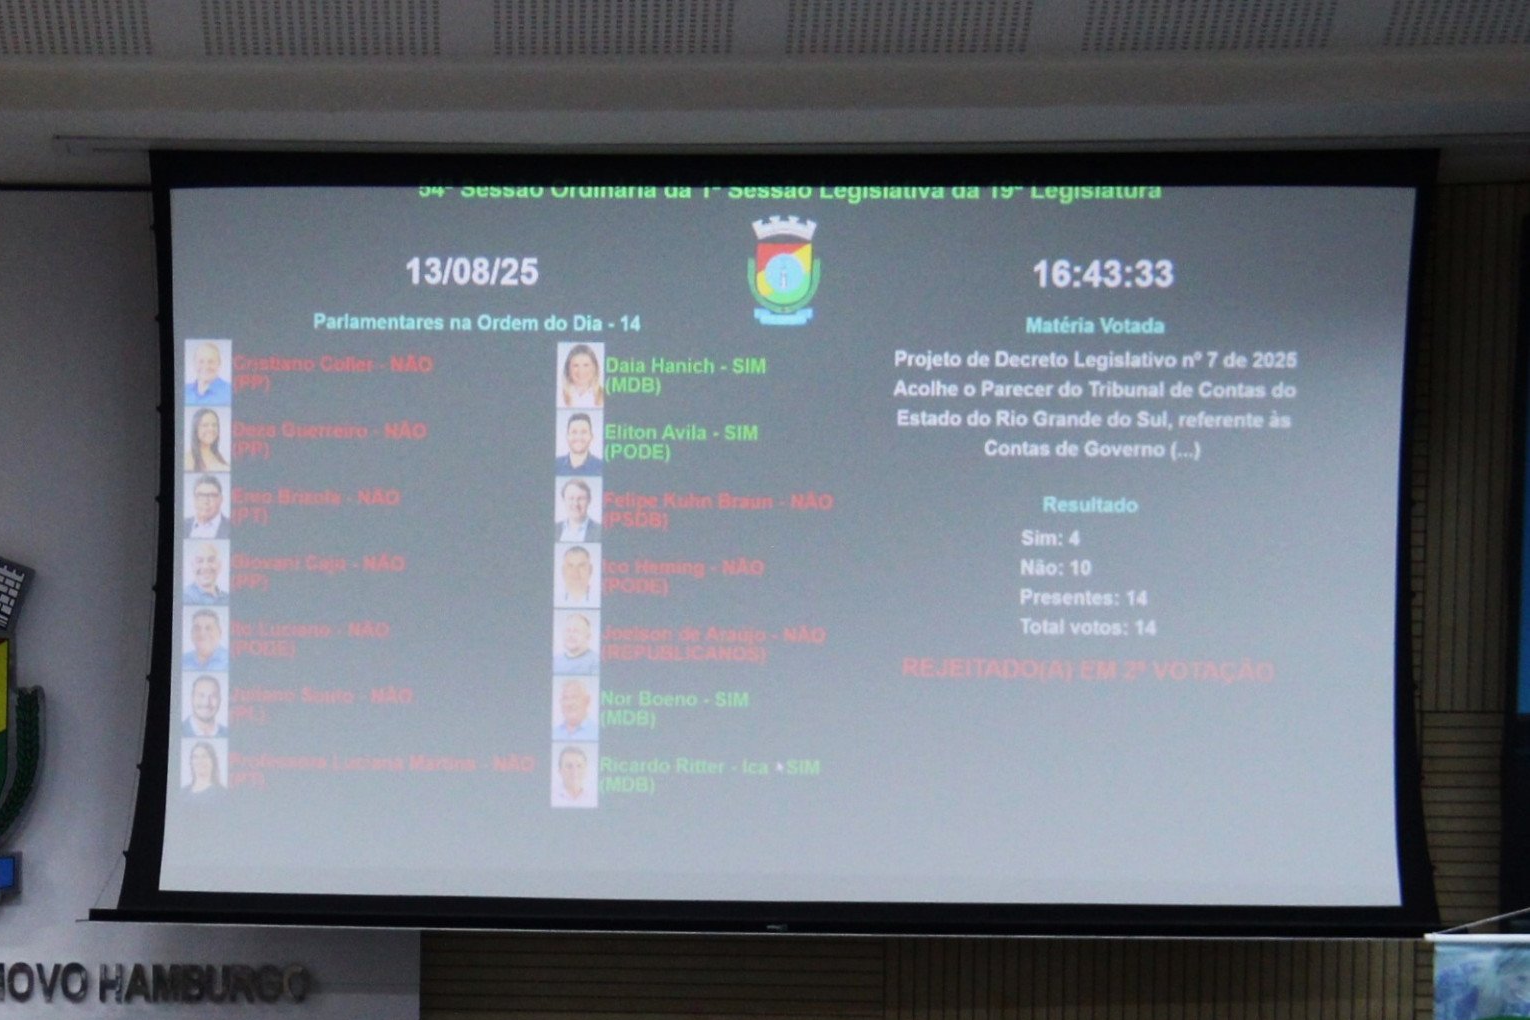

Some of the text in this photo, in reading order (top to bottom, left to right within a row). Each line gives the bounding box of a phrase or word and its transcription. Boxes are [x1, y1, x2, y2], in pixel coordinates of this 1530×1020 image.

[406, 256, 540, 286] 13/08/25
[1033, 258, 1174, 289] 16:43:33
[313, 312, 642, 332] Parlamentares na Ordem do Dia 14
[1025, 315, 1166, 335] Matéria Votada
[605, 356, 768, 375] Daia Hanich SIM
[894, 349, 963, 372] Projeto
[966, 350, 991, 368] de
[994, 349, 1069, 368] Decreto
[1073, 350, 1178, 372] Legislativo
[1207, 350, 1219, 368] 7
[1222, 351, 1248, 369] de
[1252, 351, 1298, 369] 2025
[606, 376, 662, 396] (MDB)
[892, 379, 1298, 399] Acolhe o Parecer do Tribunal de Contas do
[896, 408, 963, 427] Estado
[966, 409, 992, 427] do
[995, 409, 1029, 428] Rio
[1032, 409, 1103, 428] Grande
[1106, 410, 1133, 428] do
[1136, 410, 1174, 431] Sul,
[1178, 410, 1265, 429] referente
[605, 423, 760, 442] Eliton Avila SIM
[983, 438, 1051, 457] Contas
[1054, 439, 1080, 458] de
[1083, 439, 1167, 458] Governo
[1042, 495, 1140, 514] Resultado
[1021, 528, 1081, 547] Sim: 4
[1020, 558, 1093, 577] Não: 10
[1019, 587, 1149, 607] Presentes: 14
[678, 626, 702, 643] de
[1019, 617, 1158, 637] Total votos: 14
[601, 690, 751, 710] Nor Boeno SIM
[601, 708, 657, 728] (MDB)
[599, 756, 672, 777] Ricardo
[676, 757, 727, 775] Ritter
[786, 759, 823, 776] SIM
[599, 775, 655, 794] (MDB)
[98, 962, 310, 1005] HAMBURGO
